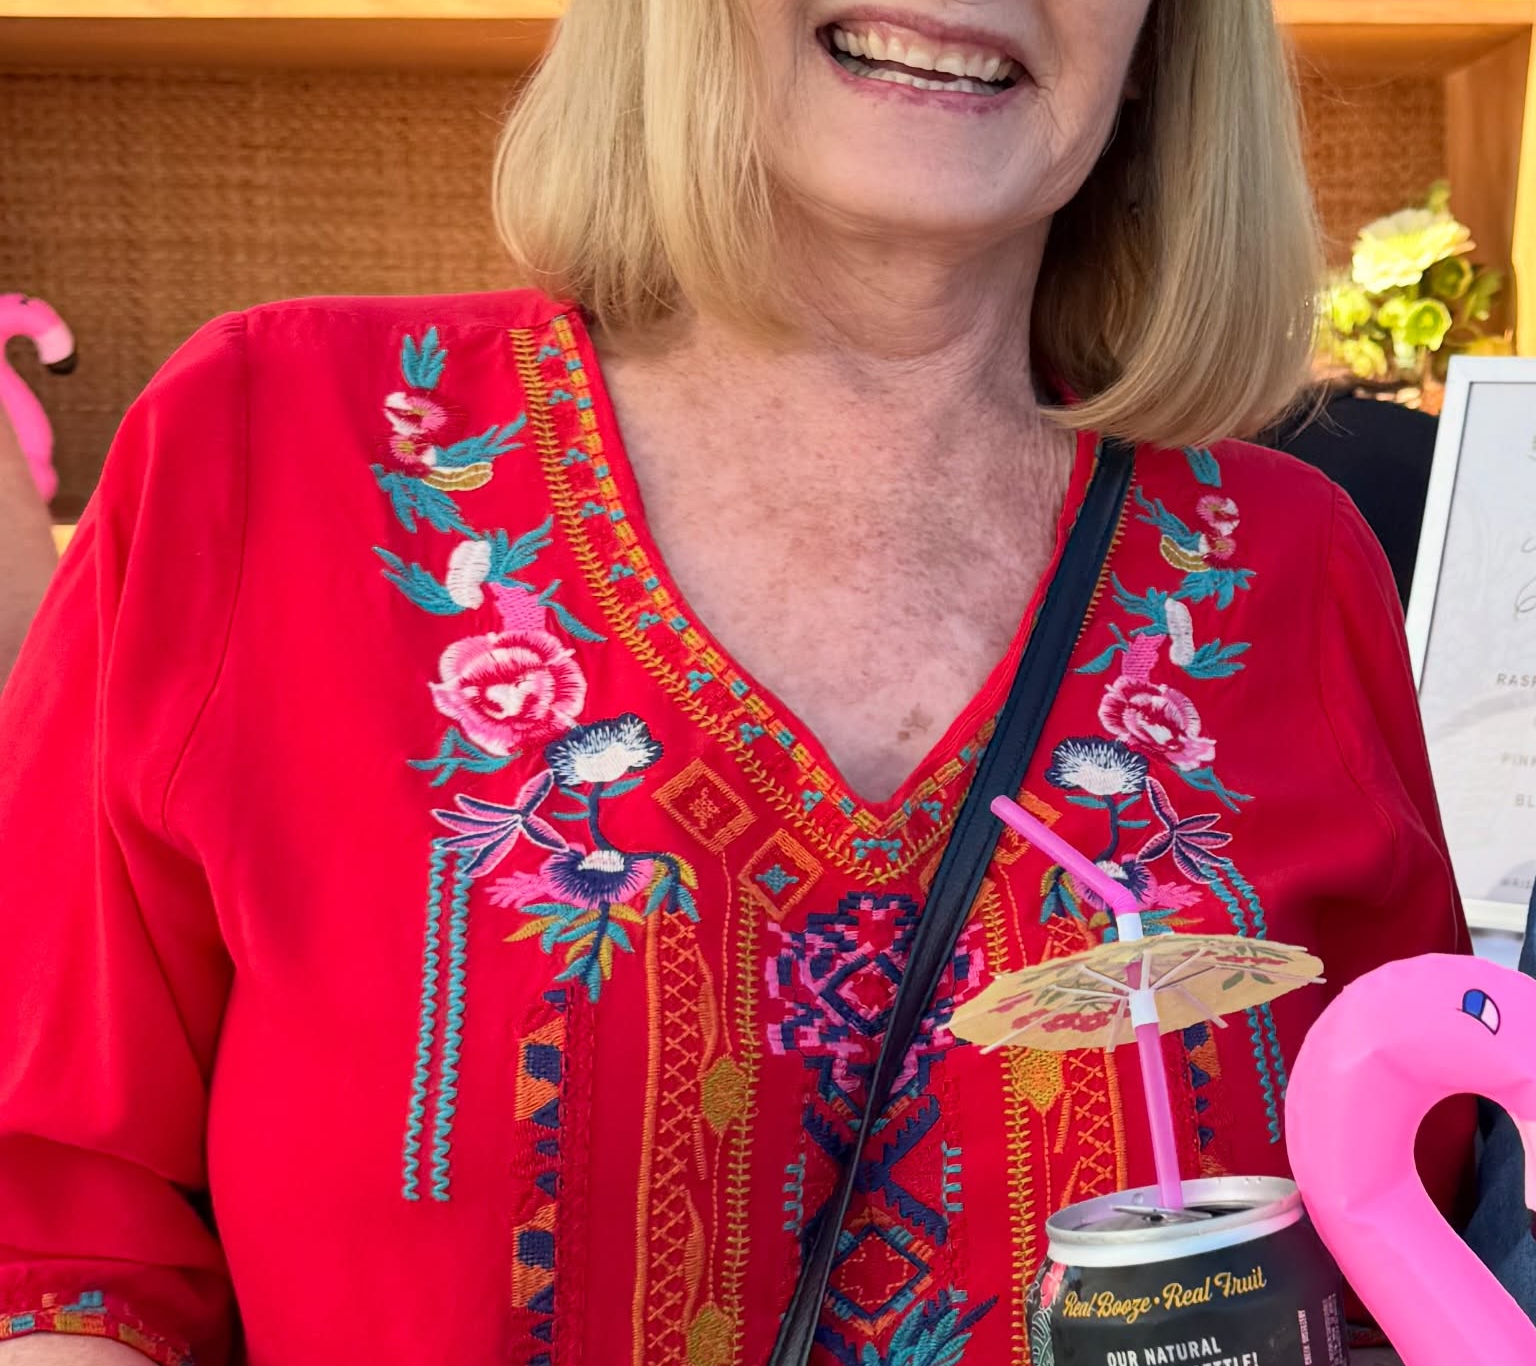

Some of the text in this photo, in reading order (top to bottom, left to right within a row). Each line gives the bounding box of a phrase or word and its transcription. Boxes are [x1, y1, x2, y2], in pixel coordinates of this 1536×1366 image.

[1063, 1266, 1267, 1324] Real Booze Real Fruit
[1144, 1337, 1221, 1366] NATURAL
